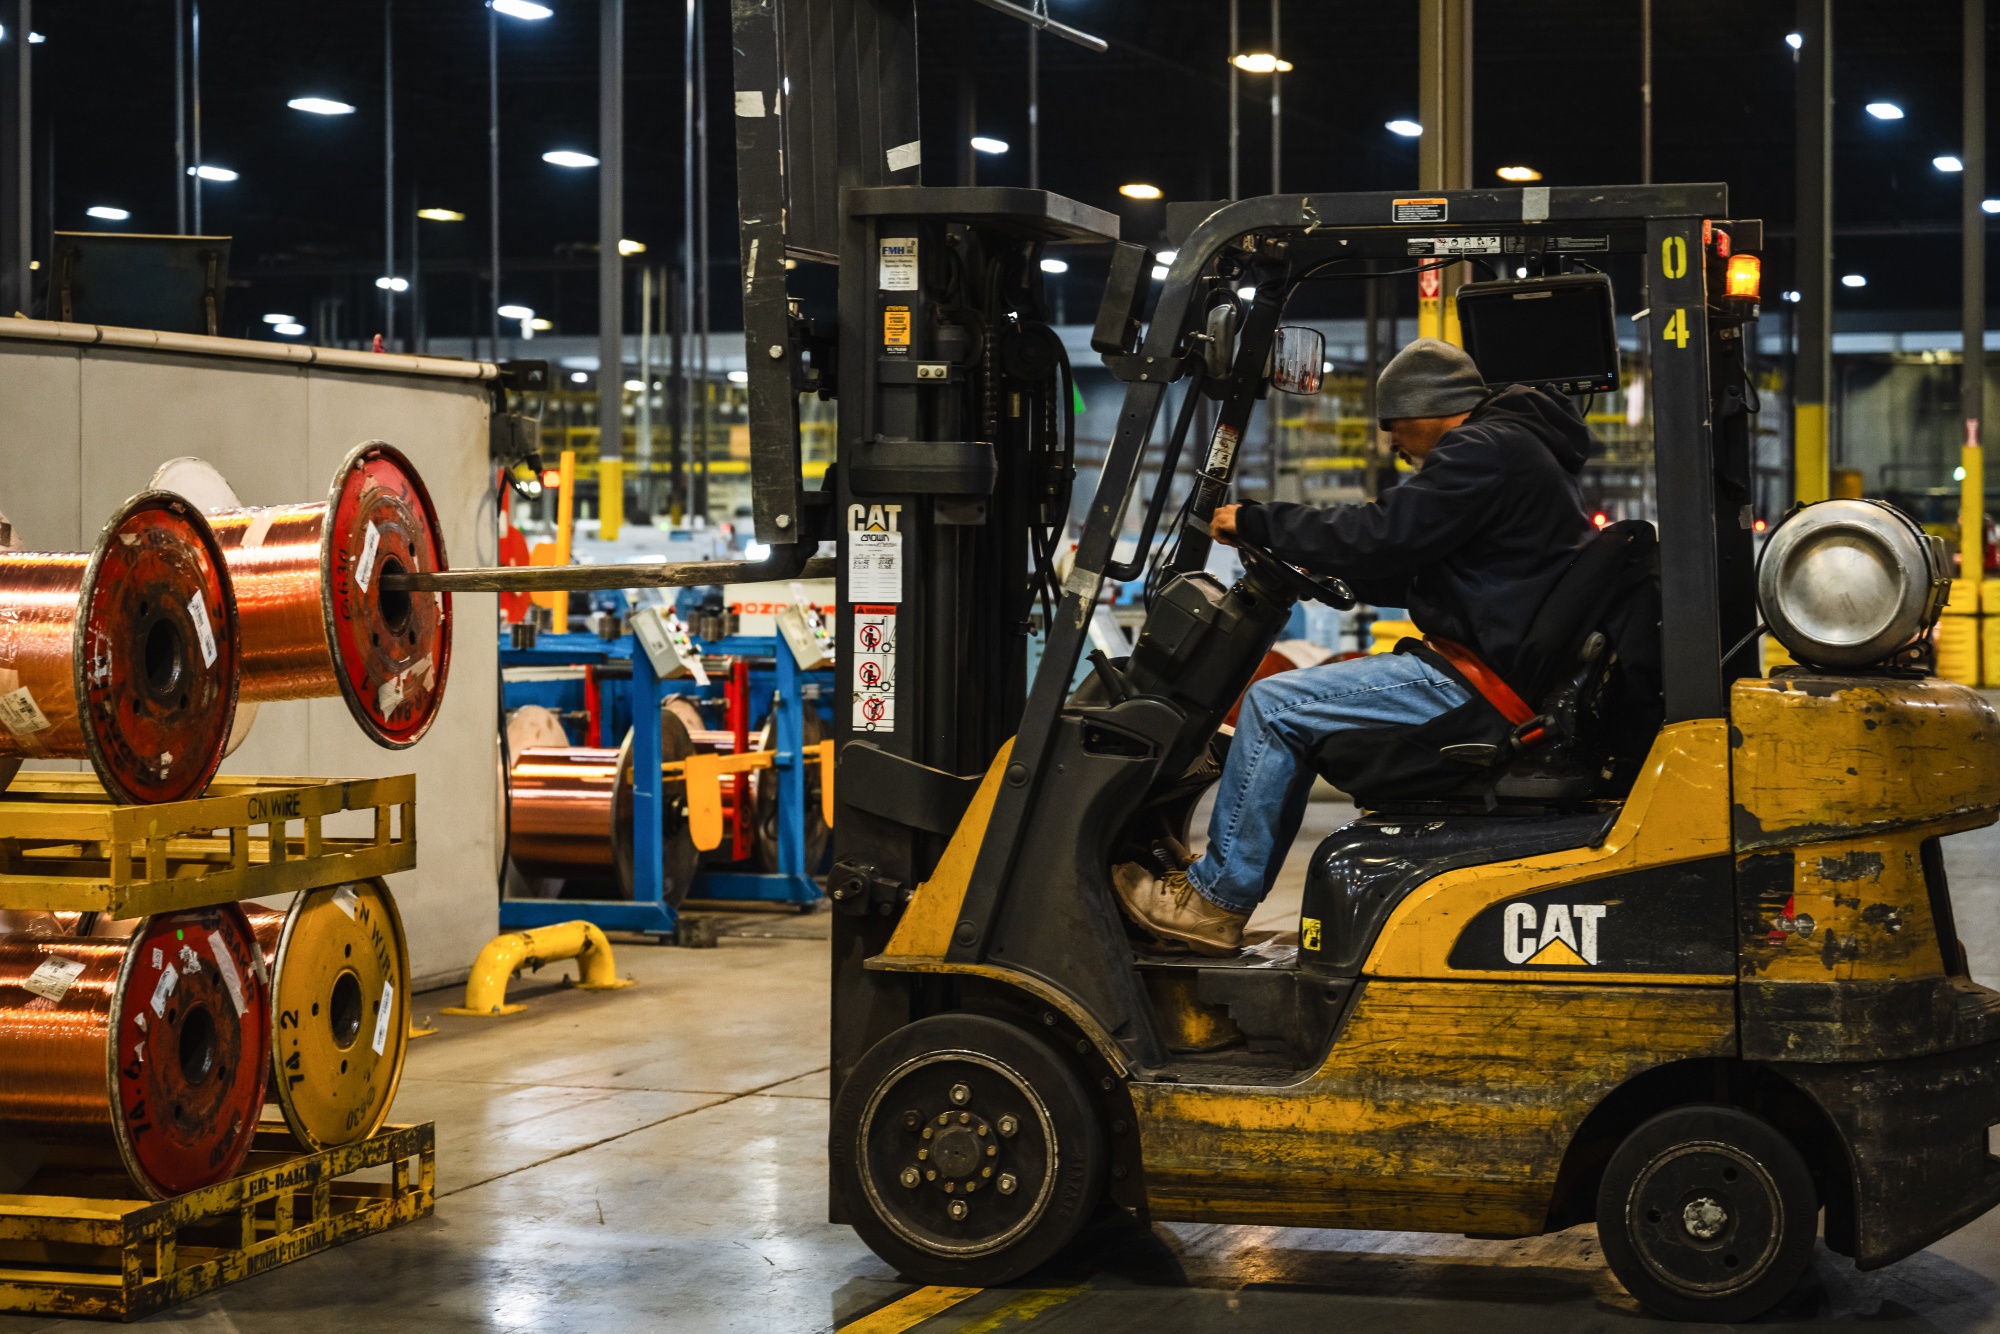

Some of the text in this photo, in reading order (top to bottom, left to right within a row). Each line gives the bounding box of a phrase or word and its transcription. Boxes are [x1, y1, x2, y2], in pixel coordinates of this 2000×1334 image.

[882, 246, 905, 255] FMH
[1662, 236, 1687, 279] 0
[1663, 308, 1690, 349] 4
[847, 503, 902, 534] CAT
[247, 792, 301, 820] CN WIRE
[1503, 902, 1606, 966] CAT
[249, 1162, 322, 1198] ER-BAK
